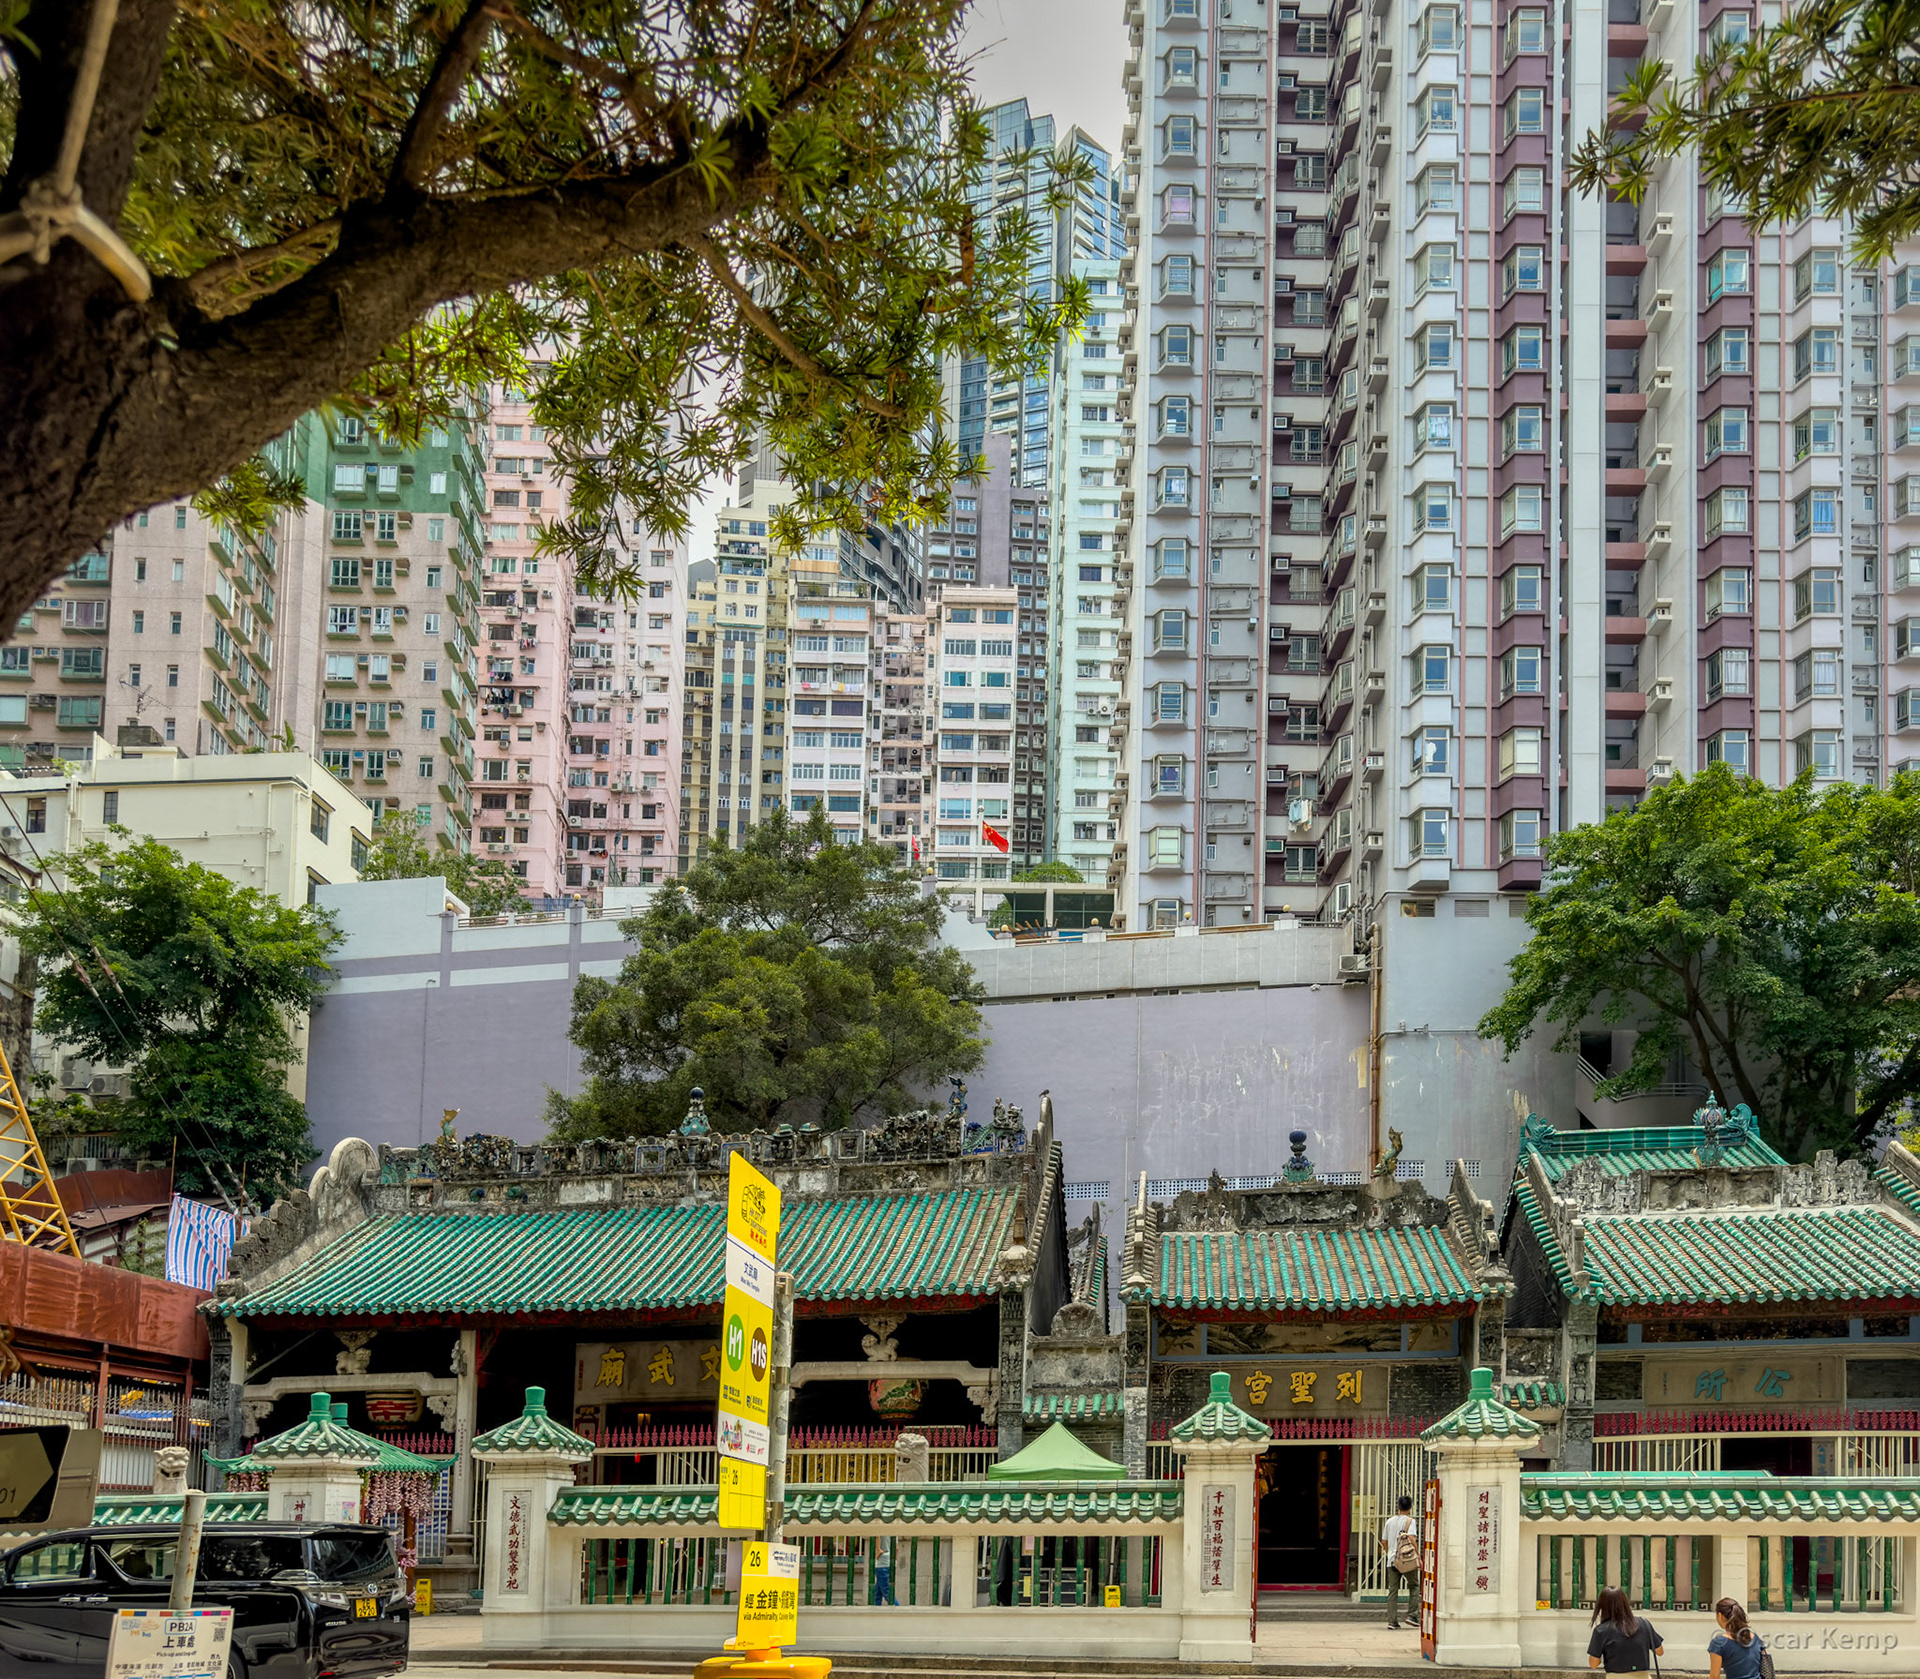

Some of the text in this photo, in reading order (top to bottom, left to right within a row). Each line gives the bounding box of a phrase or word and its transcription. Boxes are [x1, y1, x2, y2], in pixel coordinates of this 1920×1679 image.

[728, 1324, 743, 1360] H1
[751, 1338, 767, 1369] H1S
[732, 1469, 739, 1485] 26
[750, 1550, 761, 1567] 26
[743, 1612, 752, 1620] via
[169, 1621, 194, 1632] PB2A
[162, 1636, 195, 1648] 上車處
